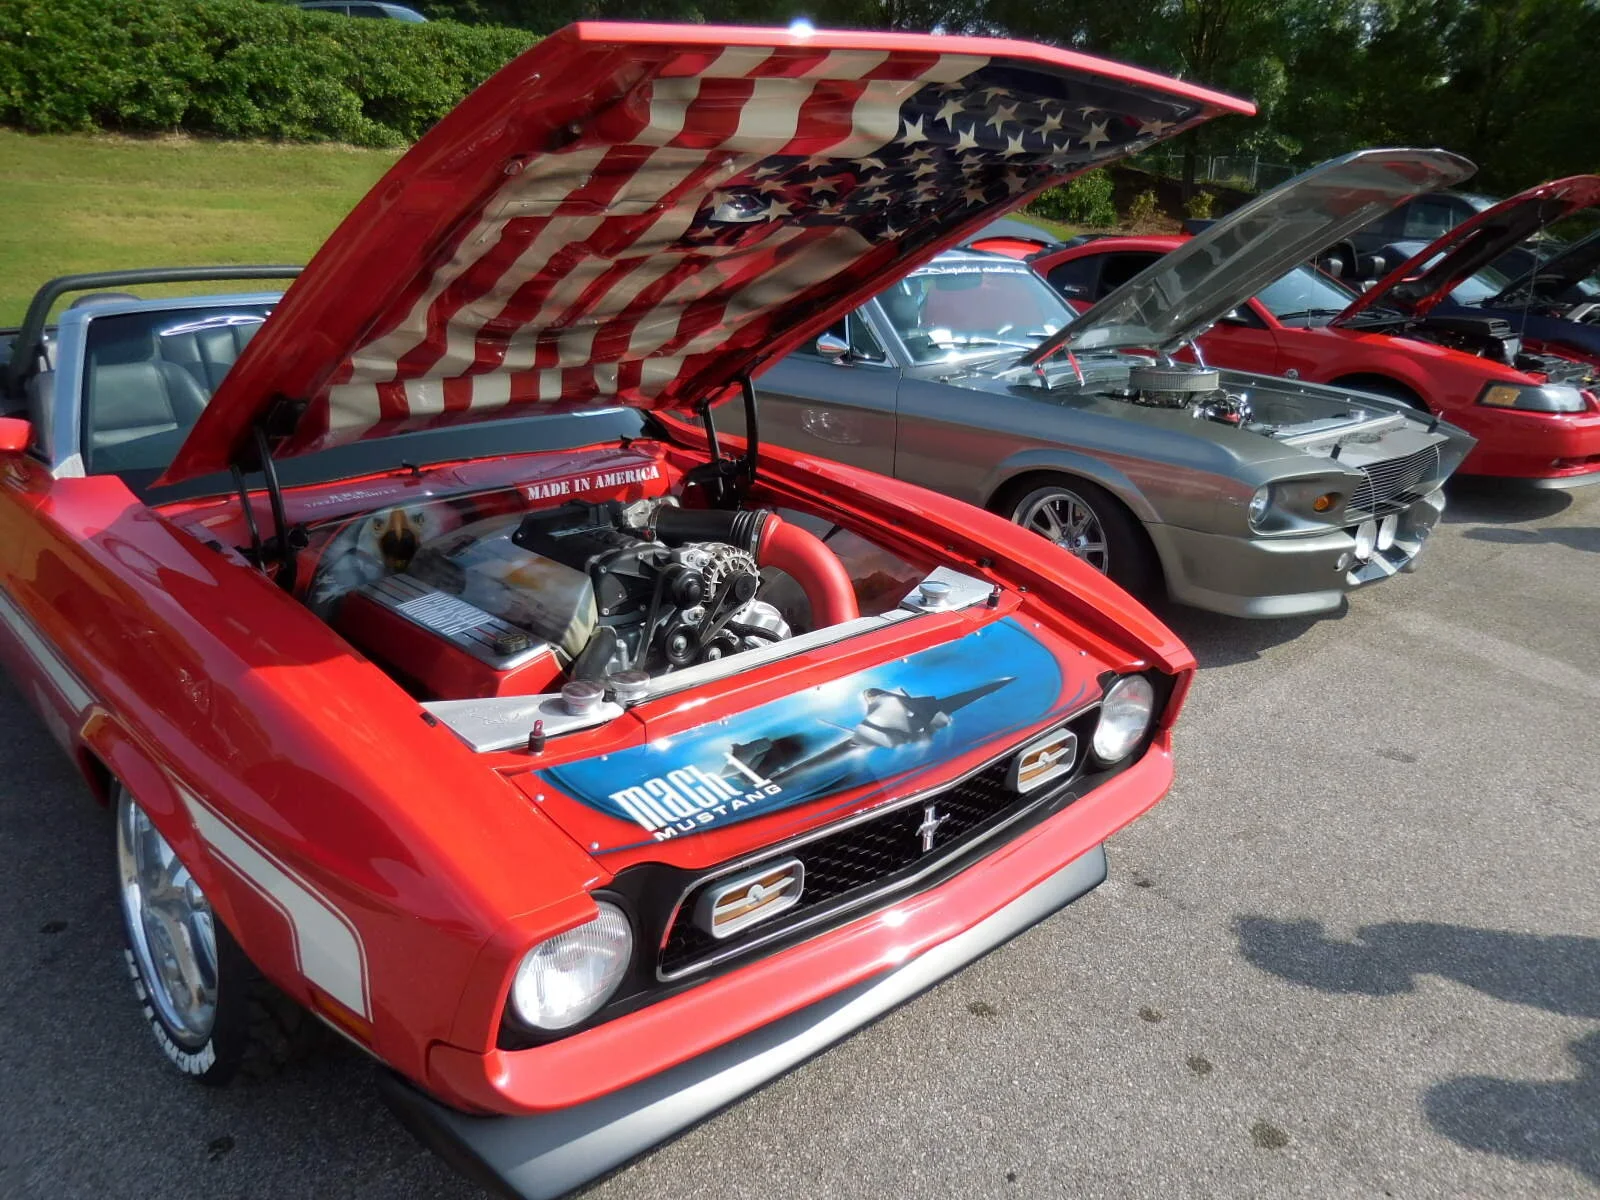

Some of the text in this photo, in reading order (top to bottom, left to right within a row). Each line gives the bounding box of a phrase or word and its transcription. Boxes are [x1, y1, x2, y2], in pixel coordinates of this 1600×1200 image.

[528, 465, 660, 501] MADE IN AMERICA
[723, 752, 773, 789] 1
[653, 783, 783, 842] MUSTANG
